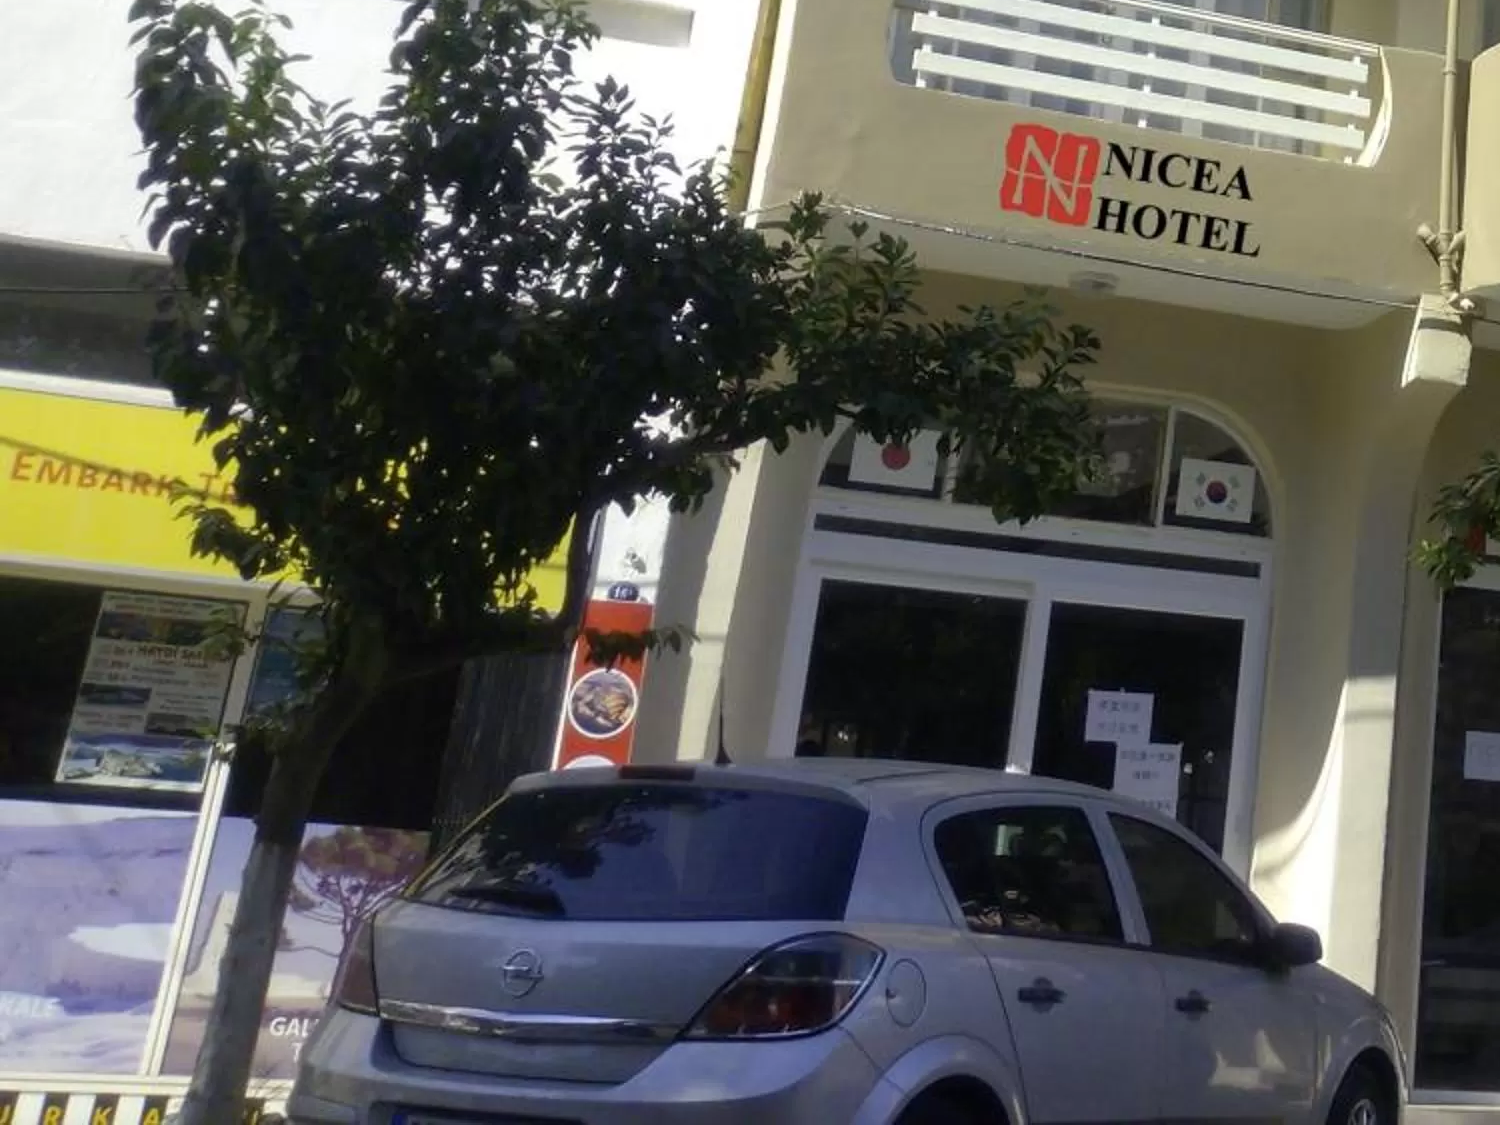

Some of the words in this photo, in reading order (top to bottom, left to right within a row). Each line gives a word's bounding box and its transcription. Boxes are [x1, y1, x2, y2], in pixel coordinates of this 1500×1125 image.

[1102, 141, 1254, 202] NICEA
[1093, 196, 1261, 258] HOTEL
[10, 449, 181, 497] EMBARK
